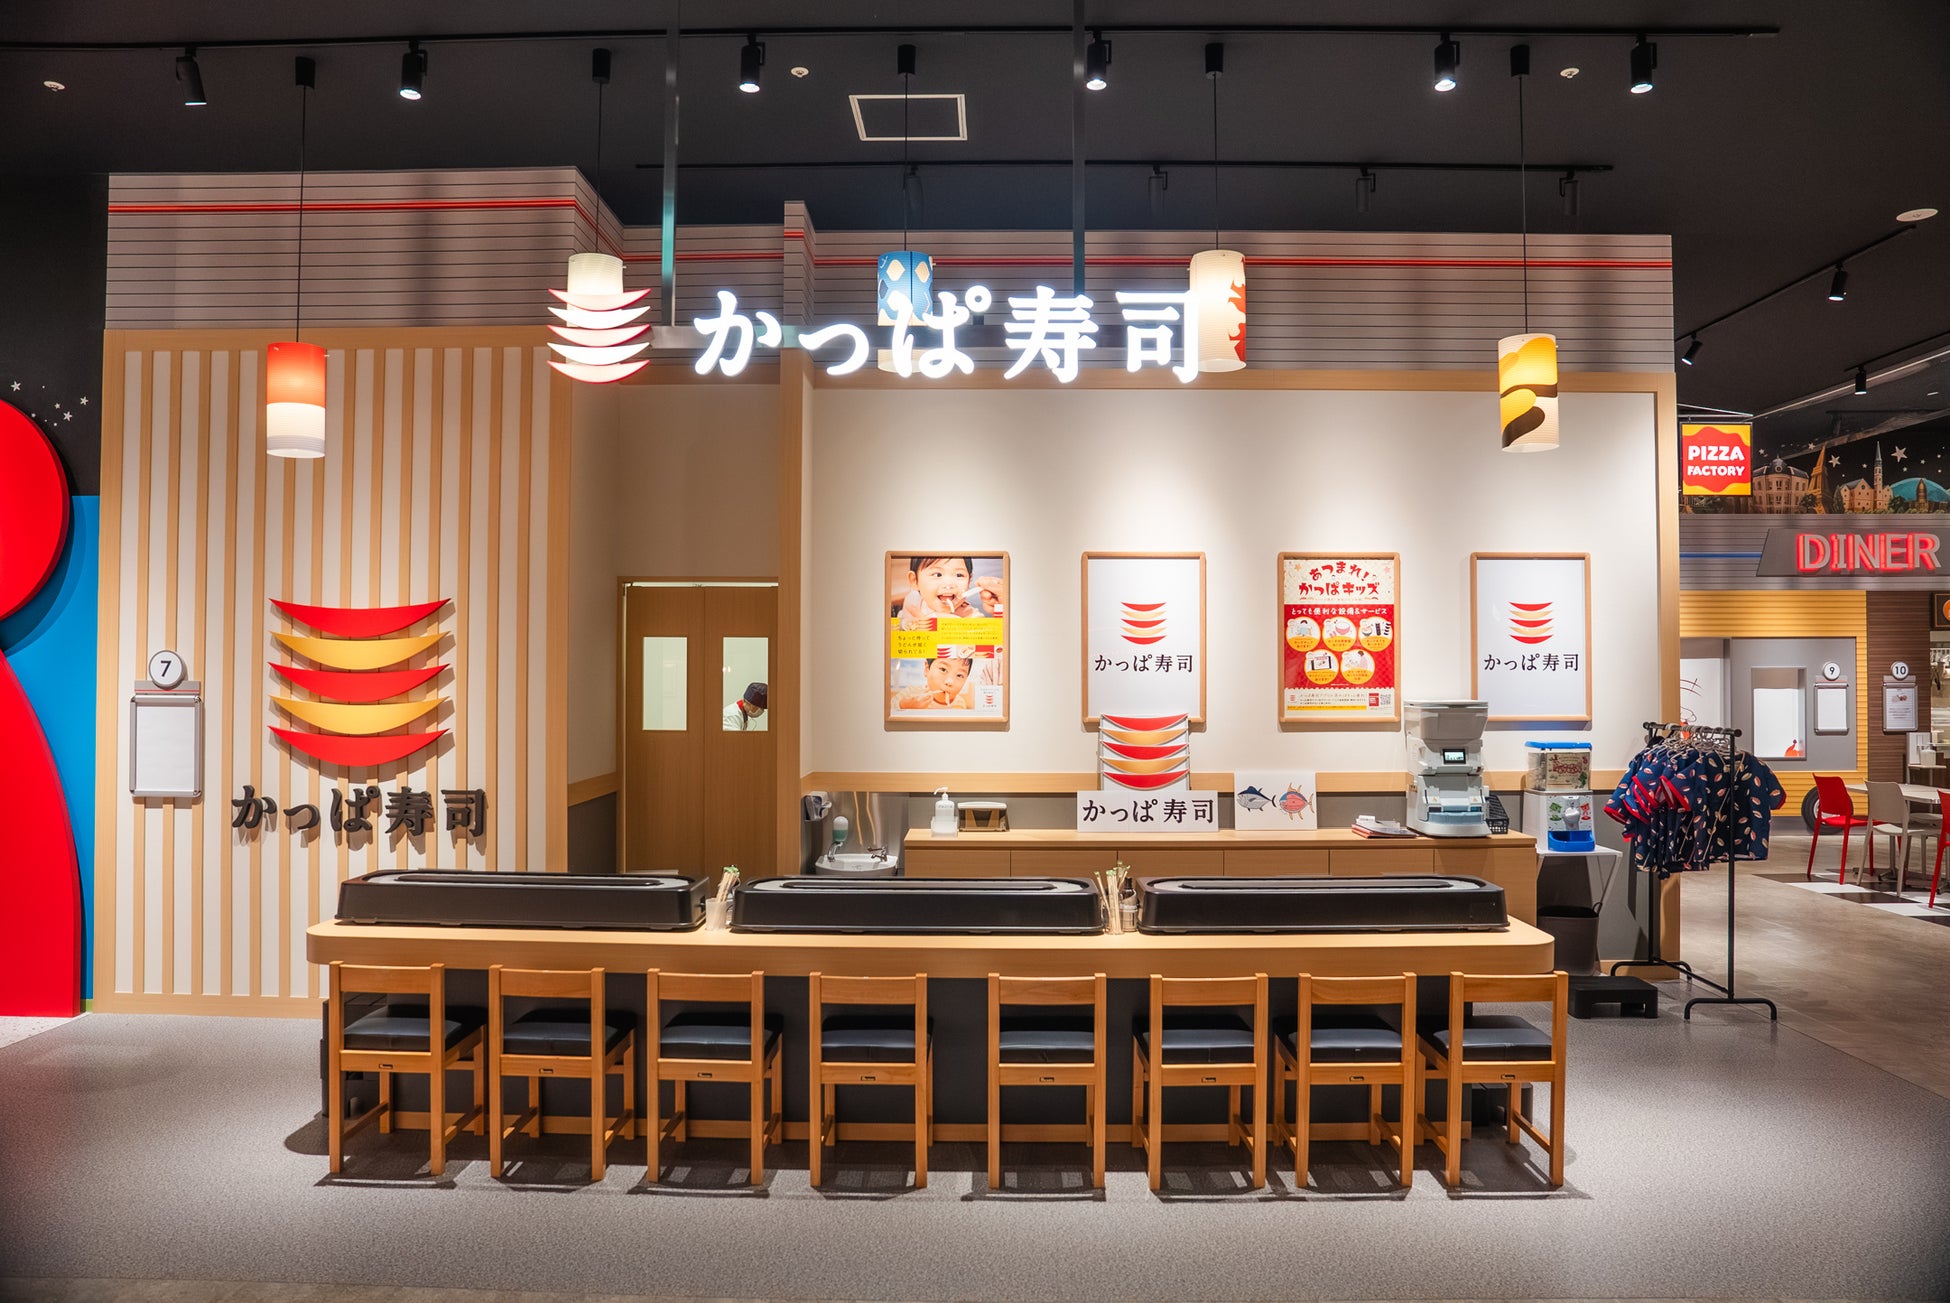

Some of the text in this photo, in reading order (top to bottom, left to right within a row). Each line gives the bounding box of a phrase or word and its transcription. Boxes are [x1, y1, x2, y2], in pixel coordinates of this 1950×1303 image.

[693, 285, 1202, 383] かっぱ寿司
[1687, 445, 1745, 461] PIZZA
[1687, 465, 1745, 477] FACTORY
[1796, 533, 1941, 571] DINER
[1309, 561, 1370, 581] あつまれ!
[1299, 582, 1380, 596] かっぱキッズ
[160, 660, 172, 677] 7
[1094, 654, 1193, 673] かっぱ寿司
[1484, 653, 1579, 671] かっぱ寿司
[1829, 666, 1835, 675] 9
[1895, 666, 1907, 675] 10
[231, 785, 489, 837] かっぱ寿司
[1082, 798, 1214, 824] かっぱ寿司
